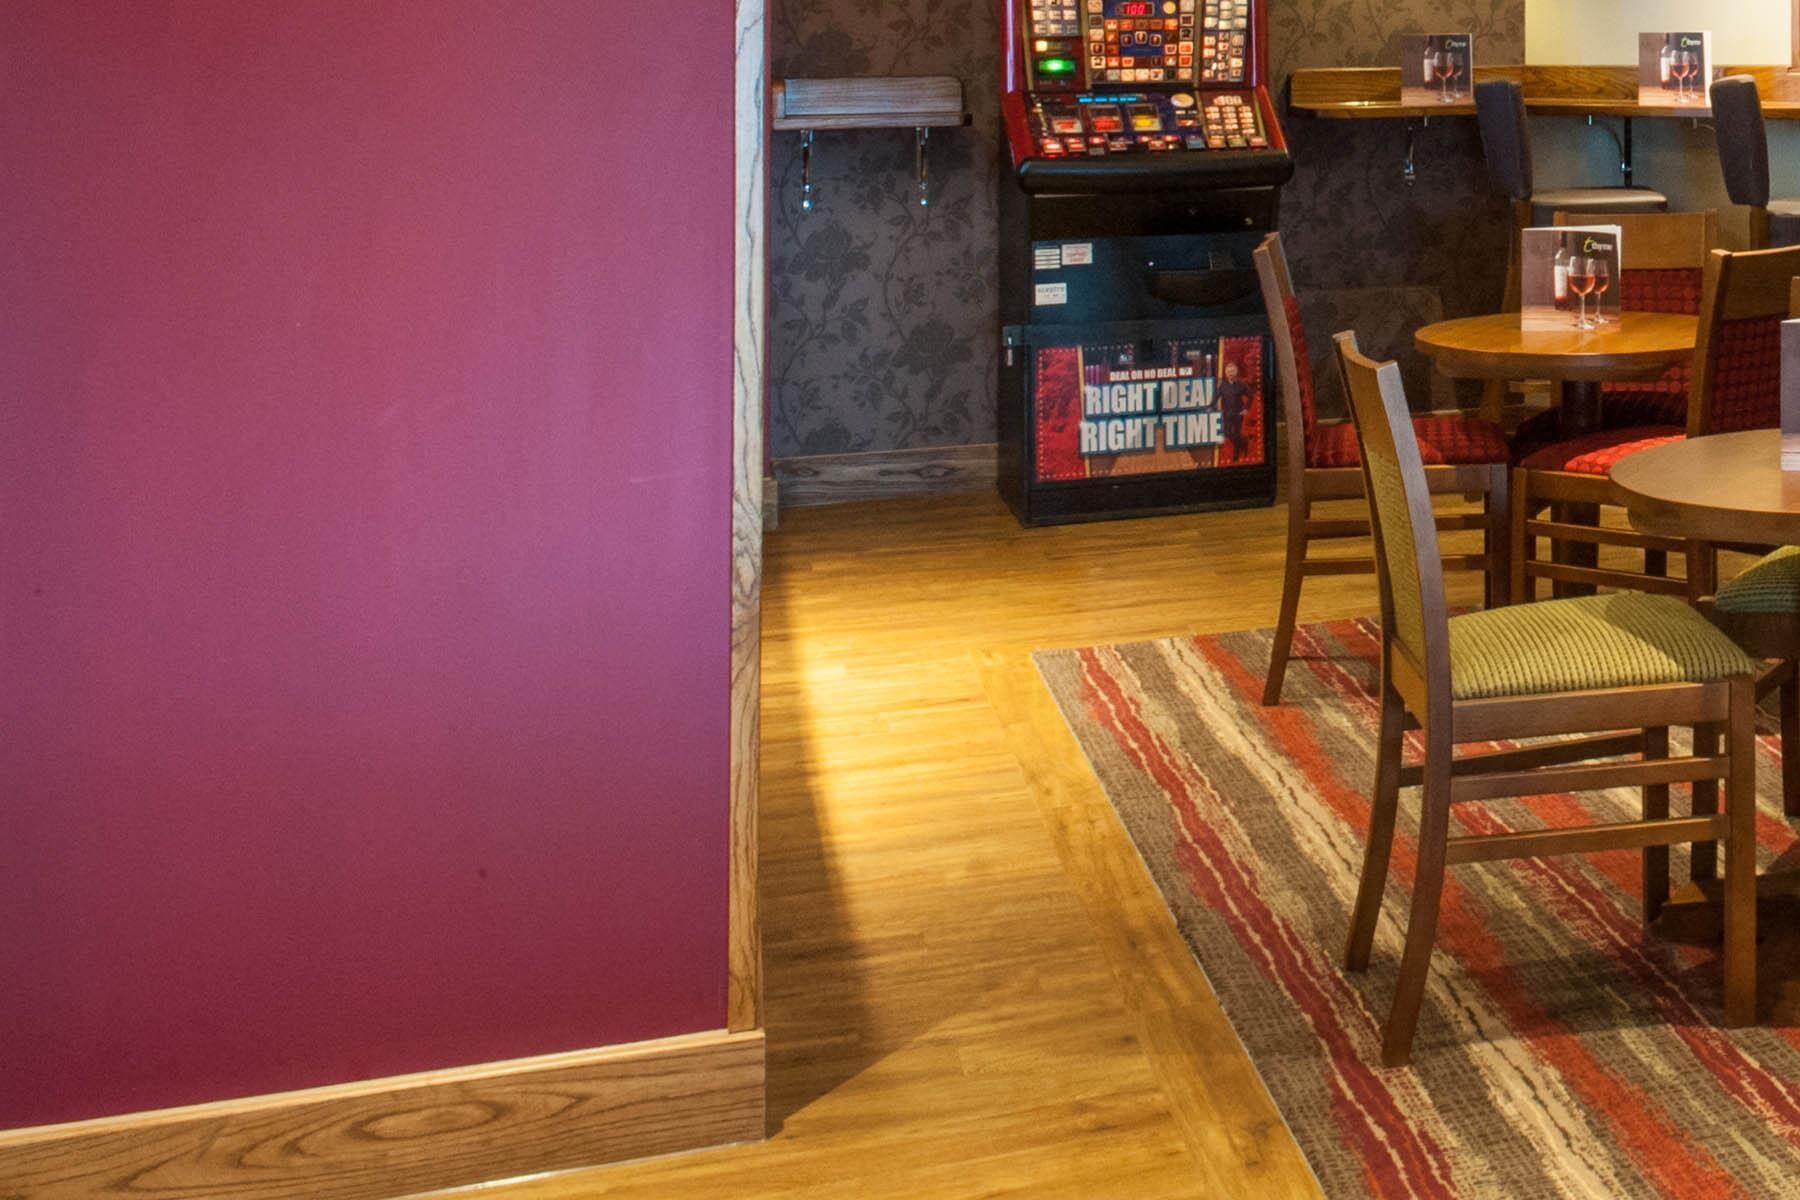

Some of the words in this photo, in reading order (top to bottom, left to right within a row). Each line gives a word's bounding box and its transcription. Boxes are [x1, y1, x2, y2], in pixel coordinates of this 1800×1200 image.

[1157, 367, 1177, 379] DEAL
[1085, 382, 1157, 415] RIGHT
[1080, 416, 1158, 453] RIGHT
[1162, 412, 1224, 446] TIME
